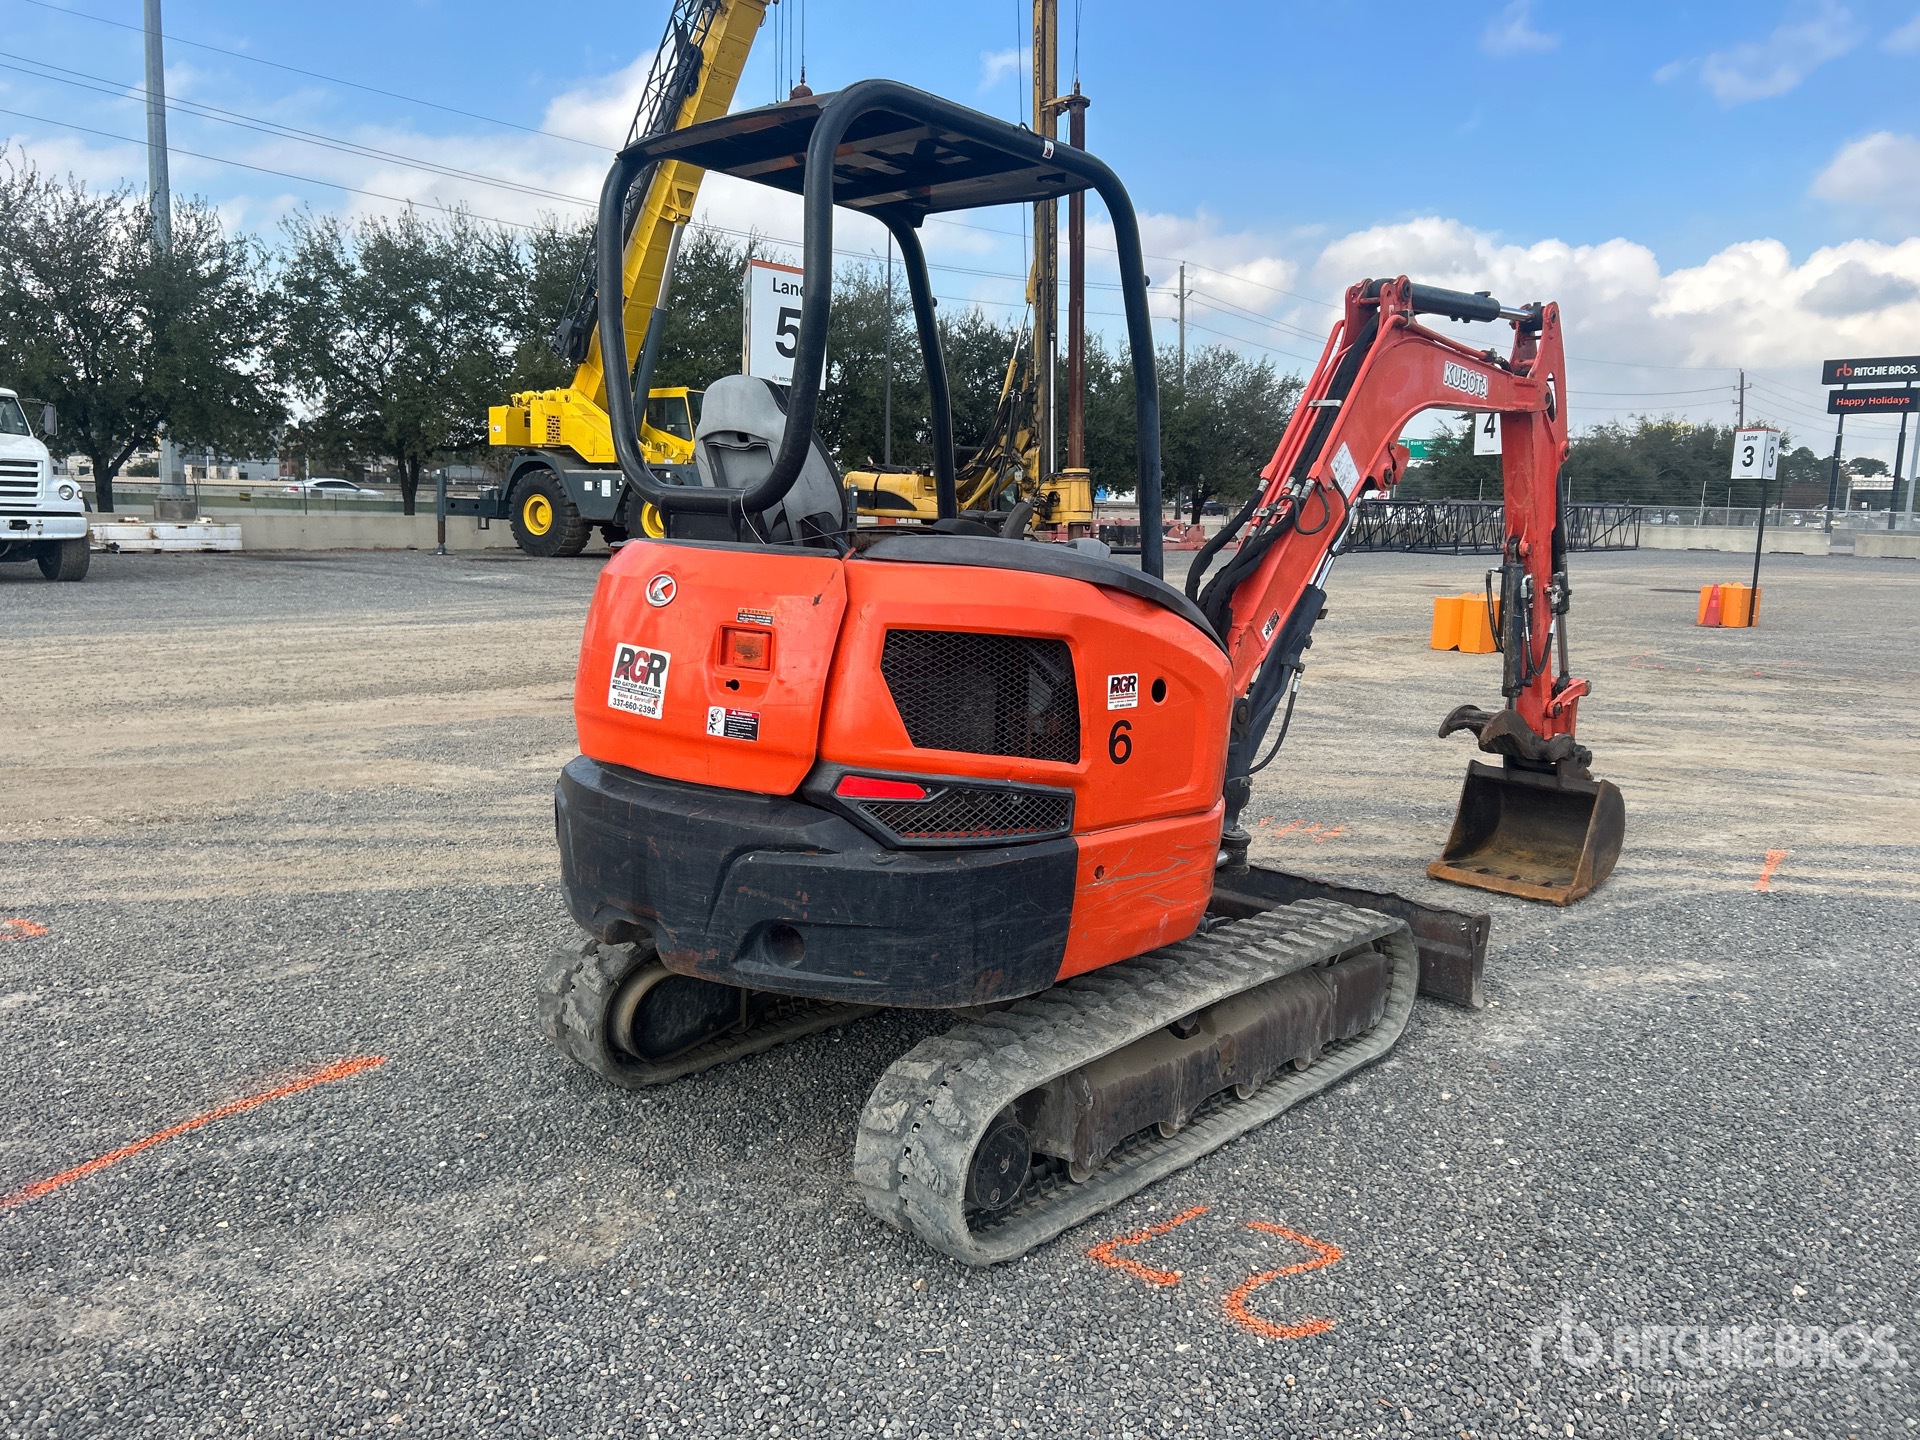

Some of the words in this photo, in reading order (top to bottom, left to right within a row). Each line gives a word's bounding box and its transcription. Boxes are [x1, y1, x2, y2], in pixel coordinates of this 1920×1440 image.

[775, 307, 803, 359] 5
[1444, 361, 1488, 398] KUBOTA
[1854, 365, 1888, 377] RITCHIE
[1888, 364, 1918, 375] BROS.
[1836, 397, 1866, 407] Happy
[1868, 396, 1910, 406] Holidays
[1483, 413, 1496, 439] 4
[1743, 434, 1758, 442] Lane
[1741, 445, 1755, 468] 3
[1768, 446, 1775, 468] 3
[614, 646, 667, 688] RGR
[622, 681, 638, 689] GATOR
[638, 684, 662, 695] RENTALS
[1110, 675, 1137, 695] RGR
[612, 697, 656, 715] 337-660-2398
[1108, 719, 1132, 765] 6
